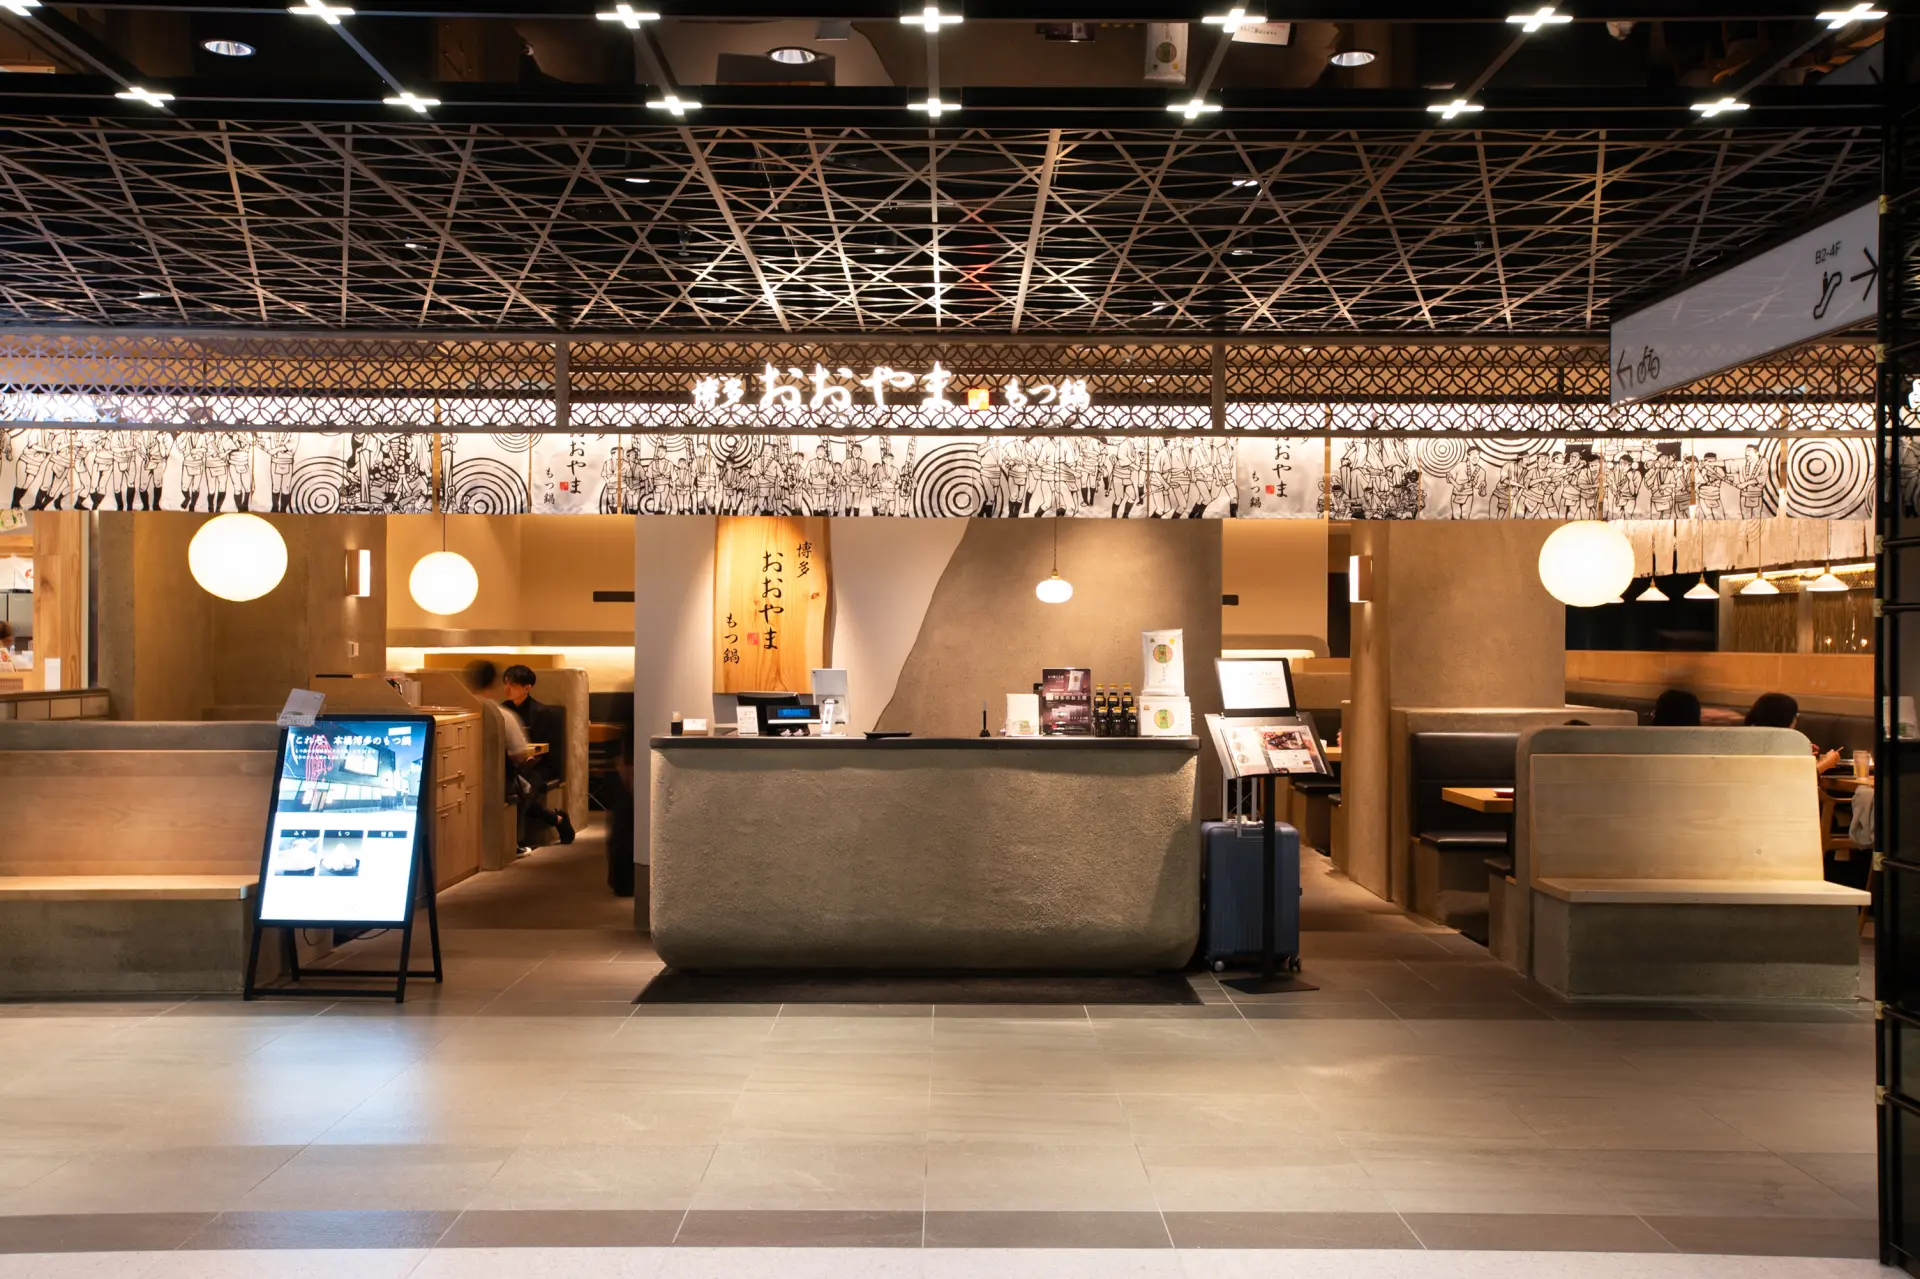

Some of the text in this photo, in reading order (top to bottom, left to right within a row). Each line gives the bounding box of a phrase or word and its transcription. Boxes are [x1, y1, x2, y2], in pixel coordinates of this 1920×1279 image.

[1815, 241, 1842, 265] B2-4F
[692, 377, 744, 407] 博多
[759, 361, 953, 411] おおやま
[1004, 377, 1091, 409] もつ鍋
[543, 467, 556, 505] もつ鍋
[1249, 470, 1262, 508] もつ鍋
[1272, 437, 1292, 498] おやま
[796, 541, 813, 578] 博多
[758, 550, 785, 650] おおやま
[723, 612, 740, 664] もつ鍋
